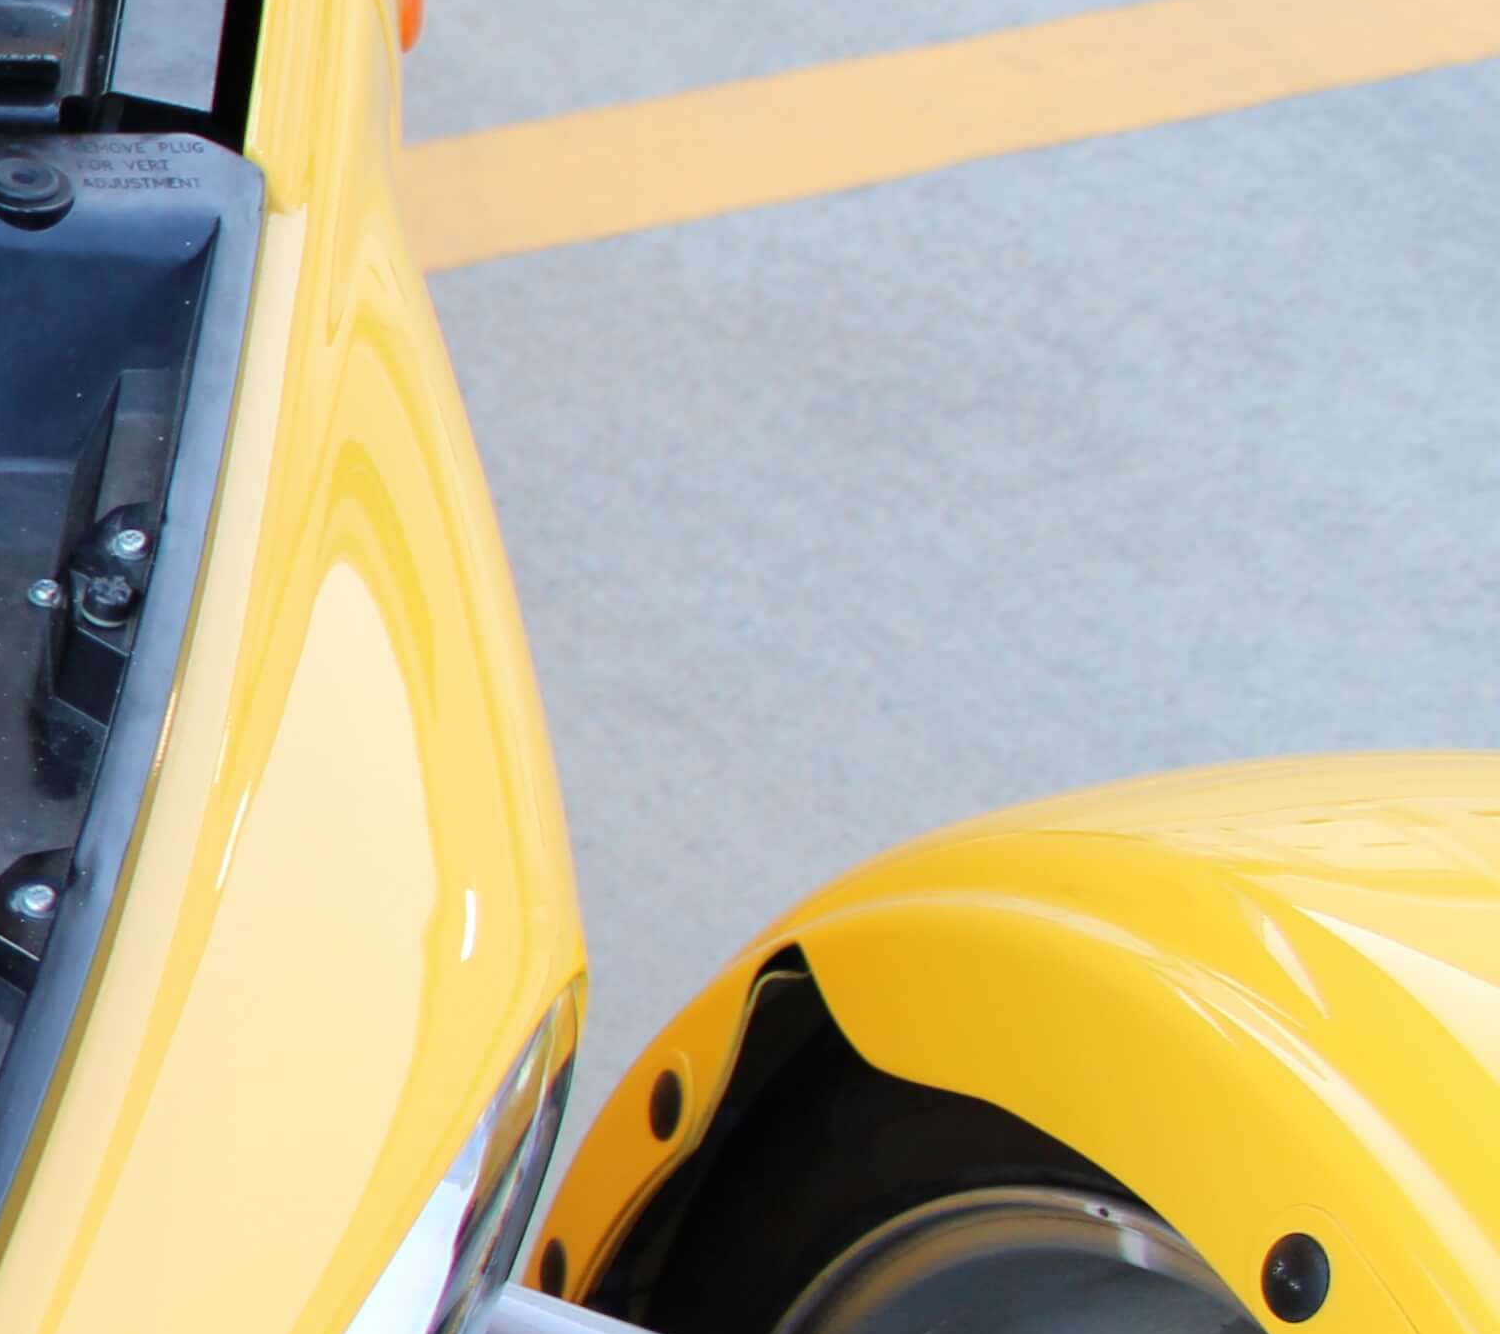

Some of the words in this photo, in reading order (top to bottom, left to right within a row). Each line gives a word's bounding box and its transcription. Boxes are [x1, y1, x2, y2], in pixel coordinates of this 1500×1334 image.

[157, 141, 205, 154] PLUG
[77, 159, 114, 171] FOR
[123, 159, 172, 172] VERT
[82, 177, 202, 190] ADJUSTMENT
